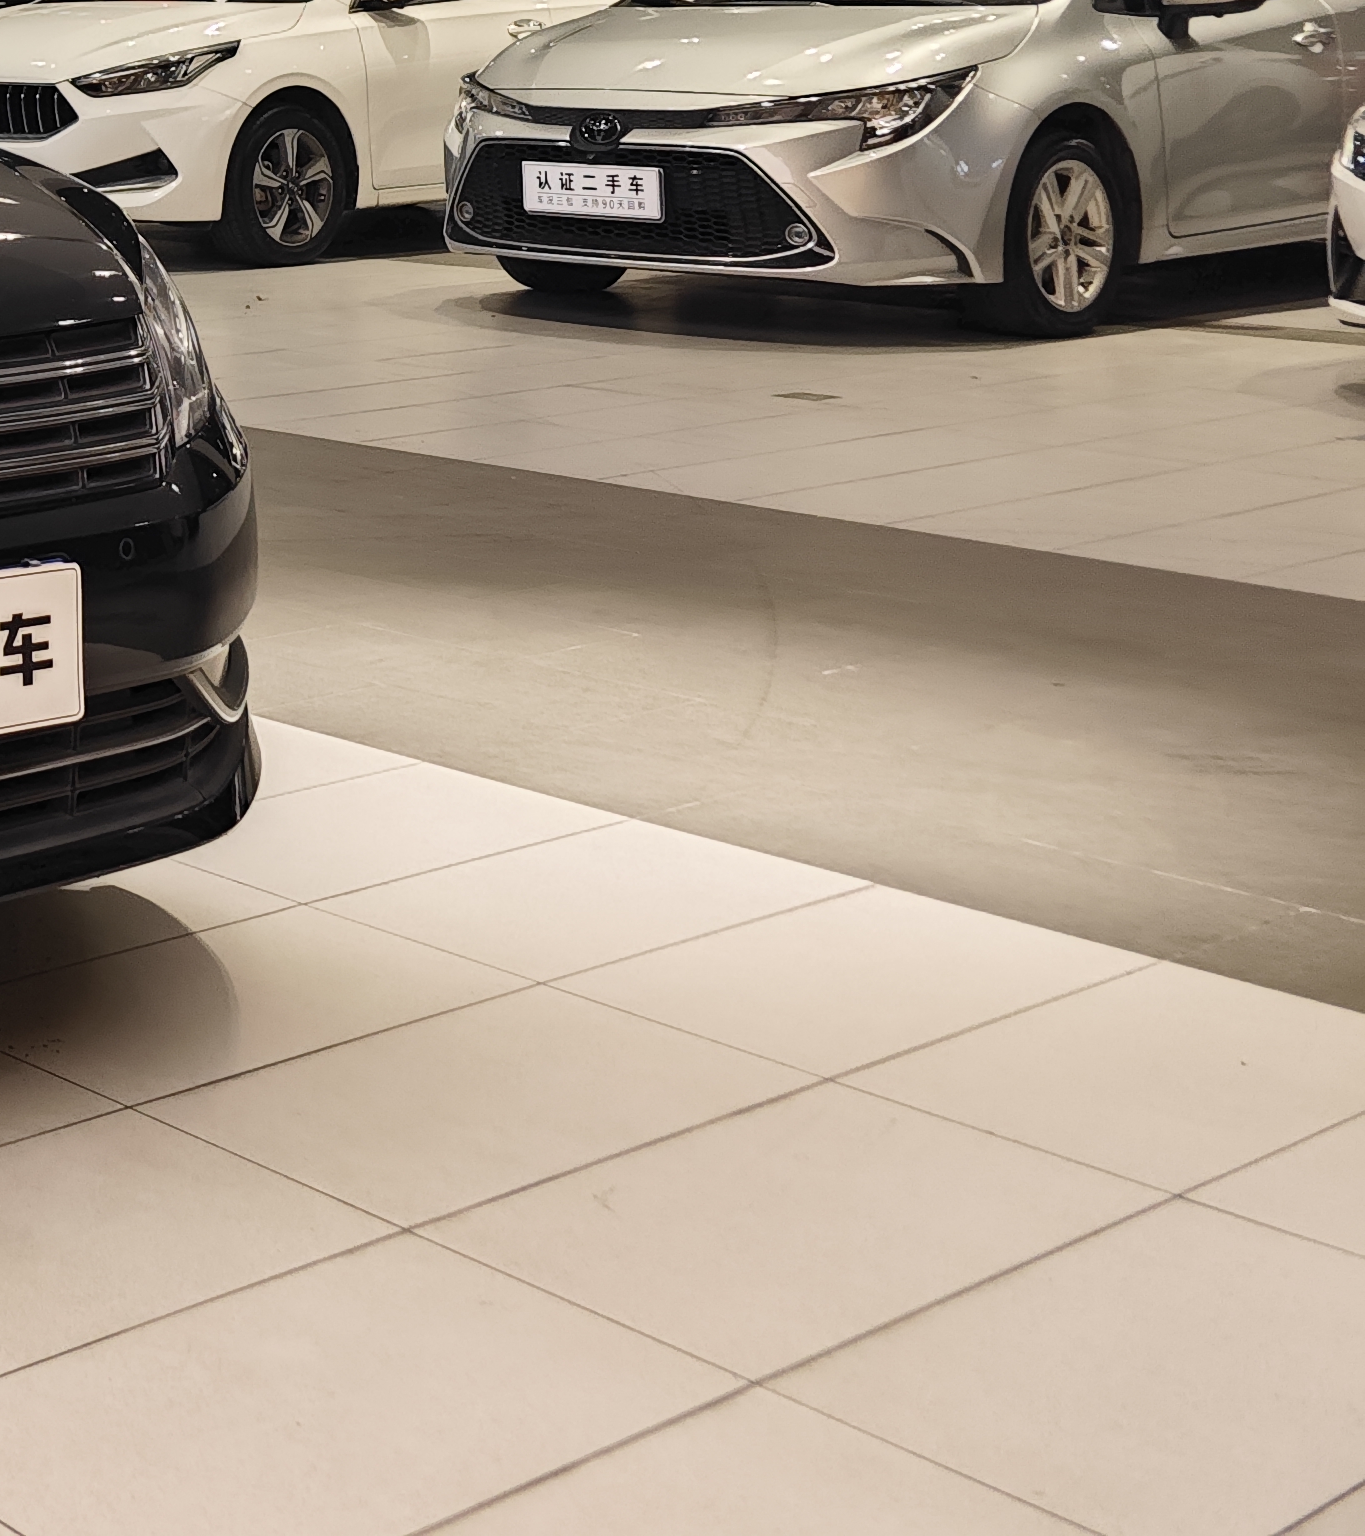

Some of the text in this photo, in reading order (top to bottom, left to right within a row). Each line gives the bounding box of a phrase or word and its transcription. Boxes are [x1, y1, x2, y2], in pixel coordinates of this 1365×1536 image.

[536, 171, 645, 196] 认证二手车
